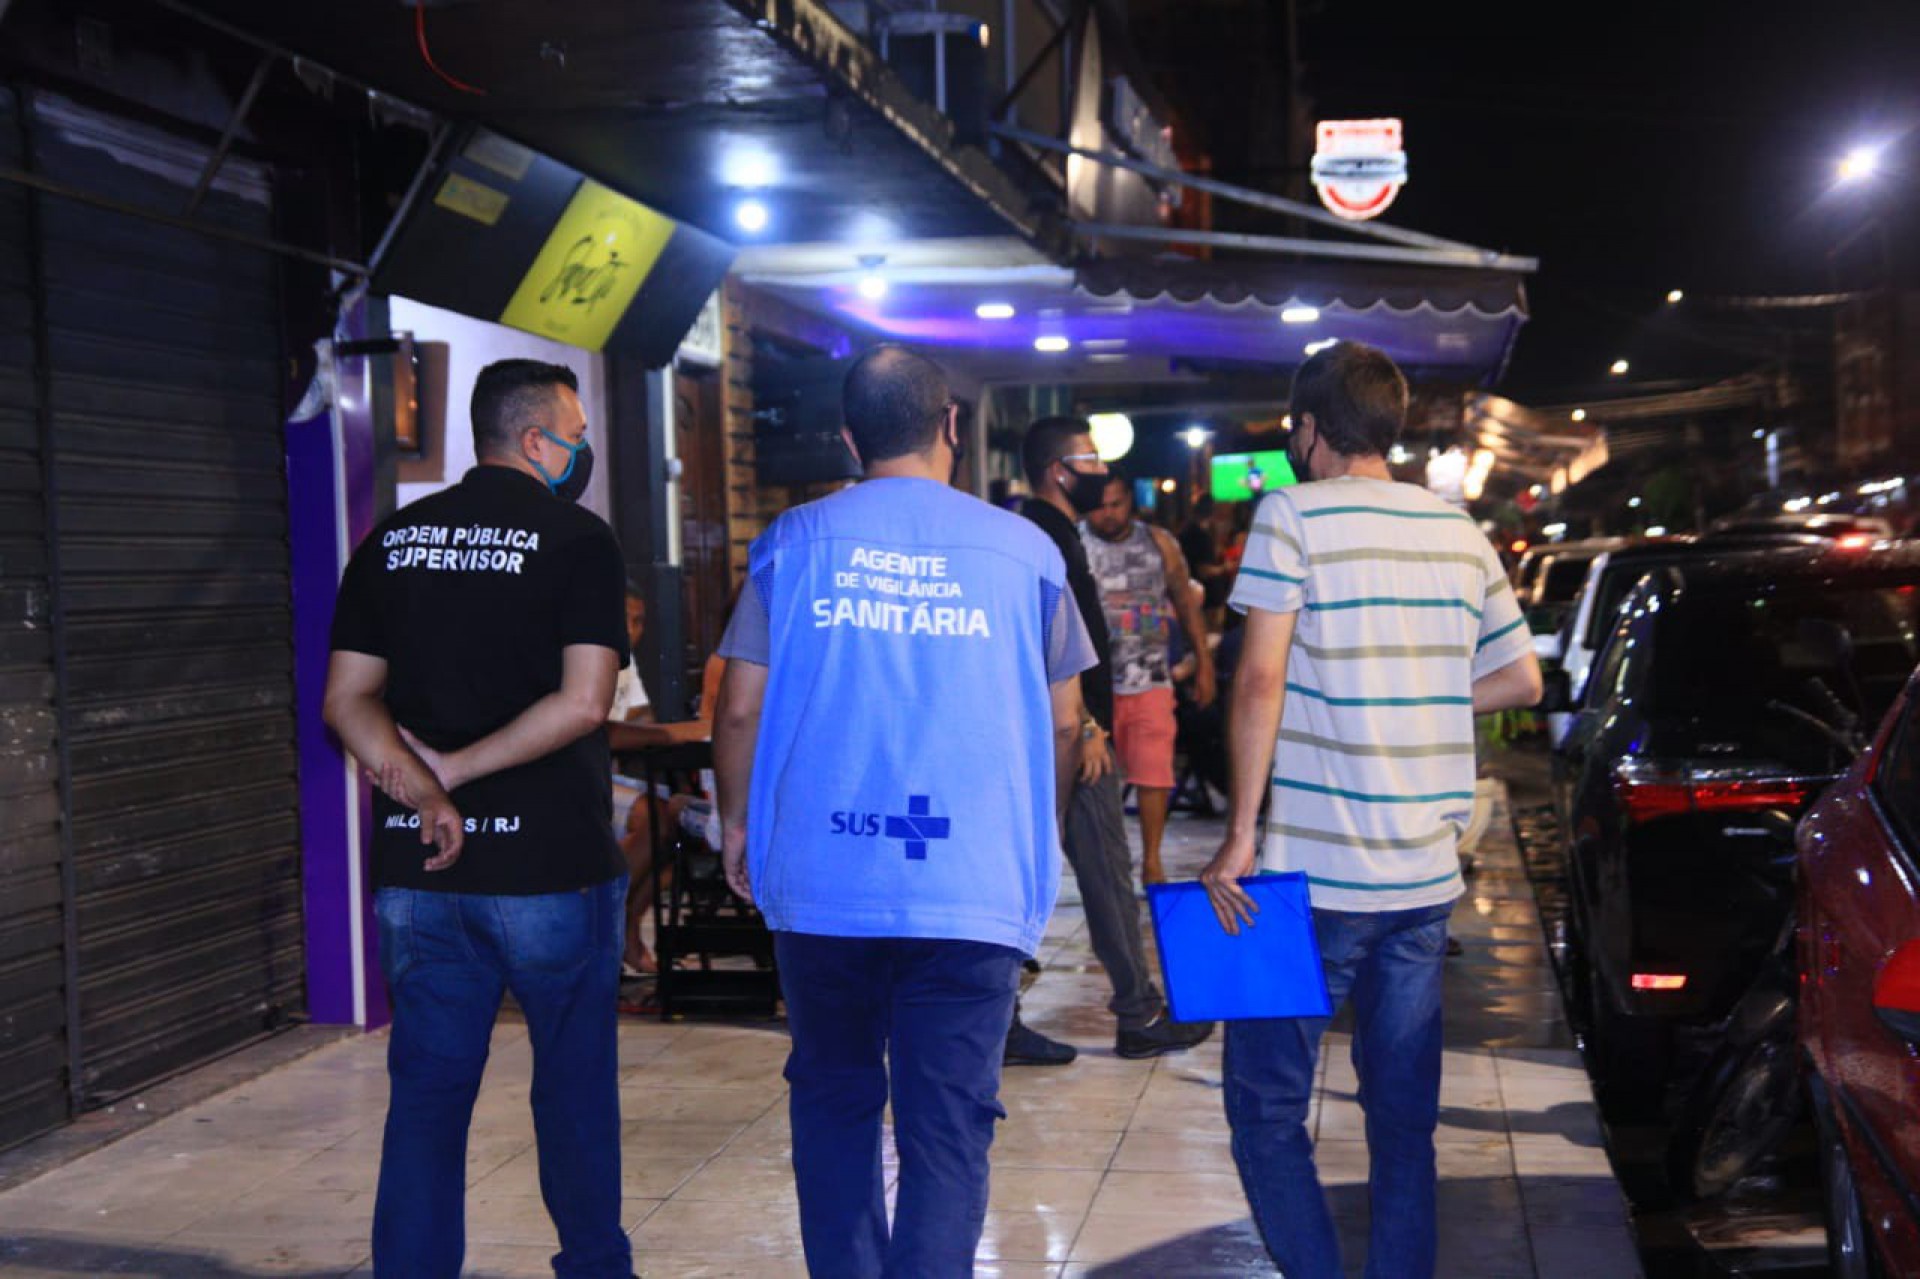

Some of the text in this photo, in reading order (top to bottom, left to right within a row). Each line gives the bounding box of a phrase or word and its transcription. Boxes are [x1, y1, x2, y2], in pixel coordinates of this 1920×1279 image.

[383, 523, 540, 550] ORDEM PÚBLICA
[386, 547, 525, 574] SUPERVISOR
[851, 547, 947, 577] AGENTE
[835, 572, 963, 598] DE VIGILÂNCIA
[813, 597, 990, 637] SANITÁRIA
[494, 815, 521, 833] RJ
[830, 810, 880, 836] SUS
